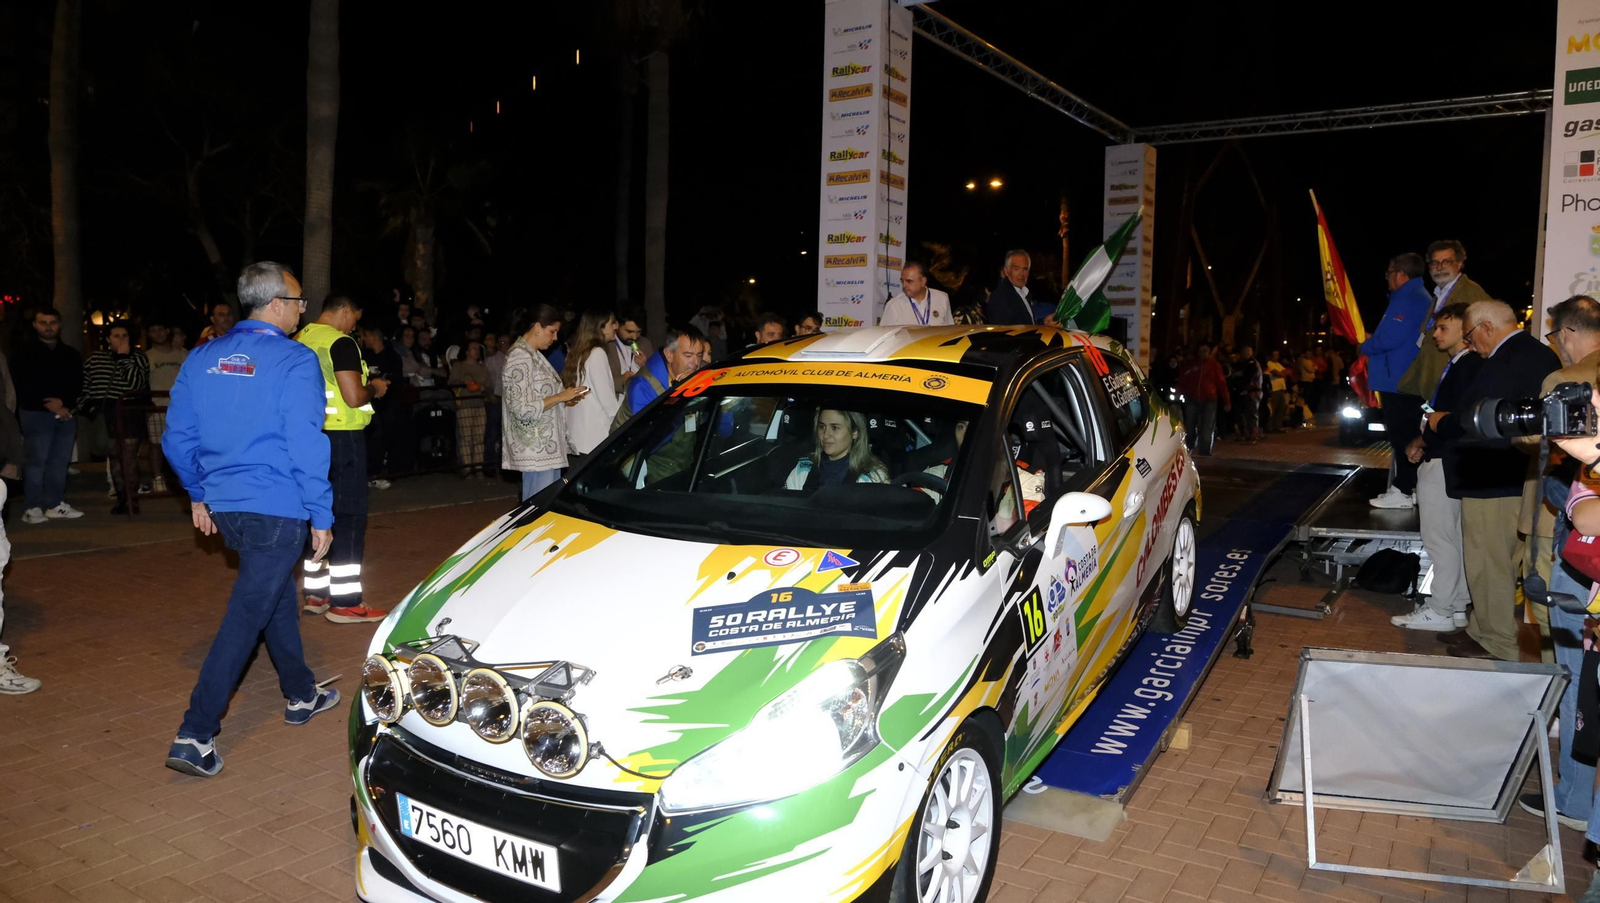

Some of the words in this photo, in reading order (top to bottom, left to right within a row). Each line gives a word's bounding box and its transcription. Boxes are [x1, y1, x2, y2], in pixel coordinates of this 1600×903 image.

[843, 24, 873, 33] MICHELIN
[832, 64, 872, 76] Rallycar
[838, 86, 864, 98] Recalvi
[840, 110, 870, 118] MICHELIN
[830, 149, 869, 161] Rallycar
[835, 172, 862, 183] Recalvi
[827, 233, 867, 244] Rallycar
[833, 256, 859, 265] Recalvi
[825, 316, 864, 327] Rallycar
[734, 369, 799, 378] AUTOMÓVIL
[854, 371, 912, 383] ALMERÍA
[770, 591, 793, 603] 16
[708, 613, 744, 629] 50
[745, 601, 857, 624] RALLYE
[1023, 592, 1044, 645] 16
[708, 624, 759, 638] COSTA
[762, 622, 783, 631] DE
[411, 804, 472, 856] 7560
[493, 835, 546, 883] KMW
